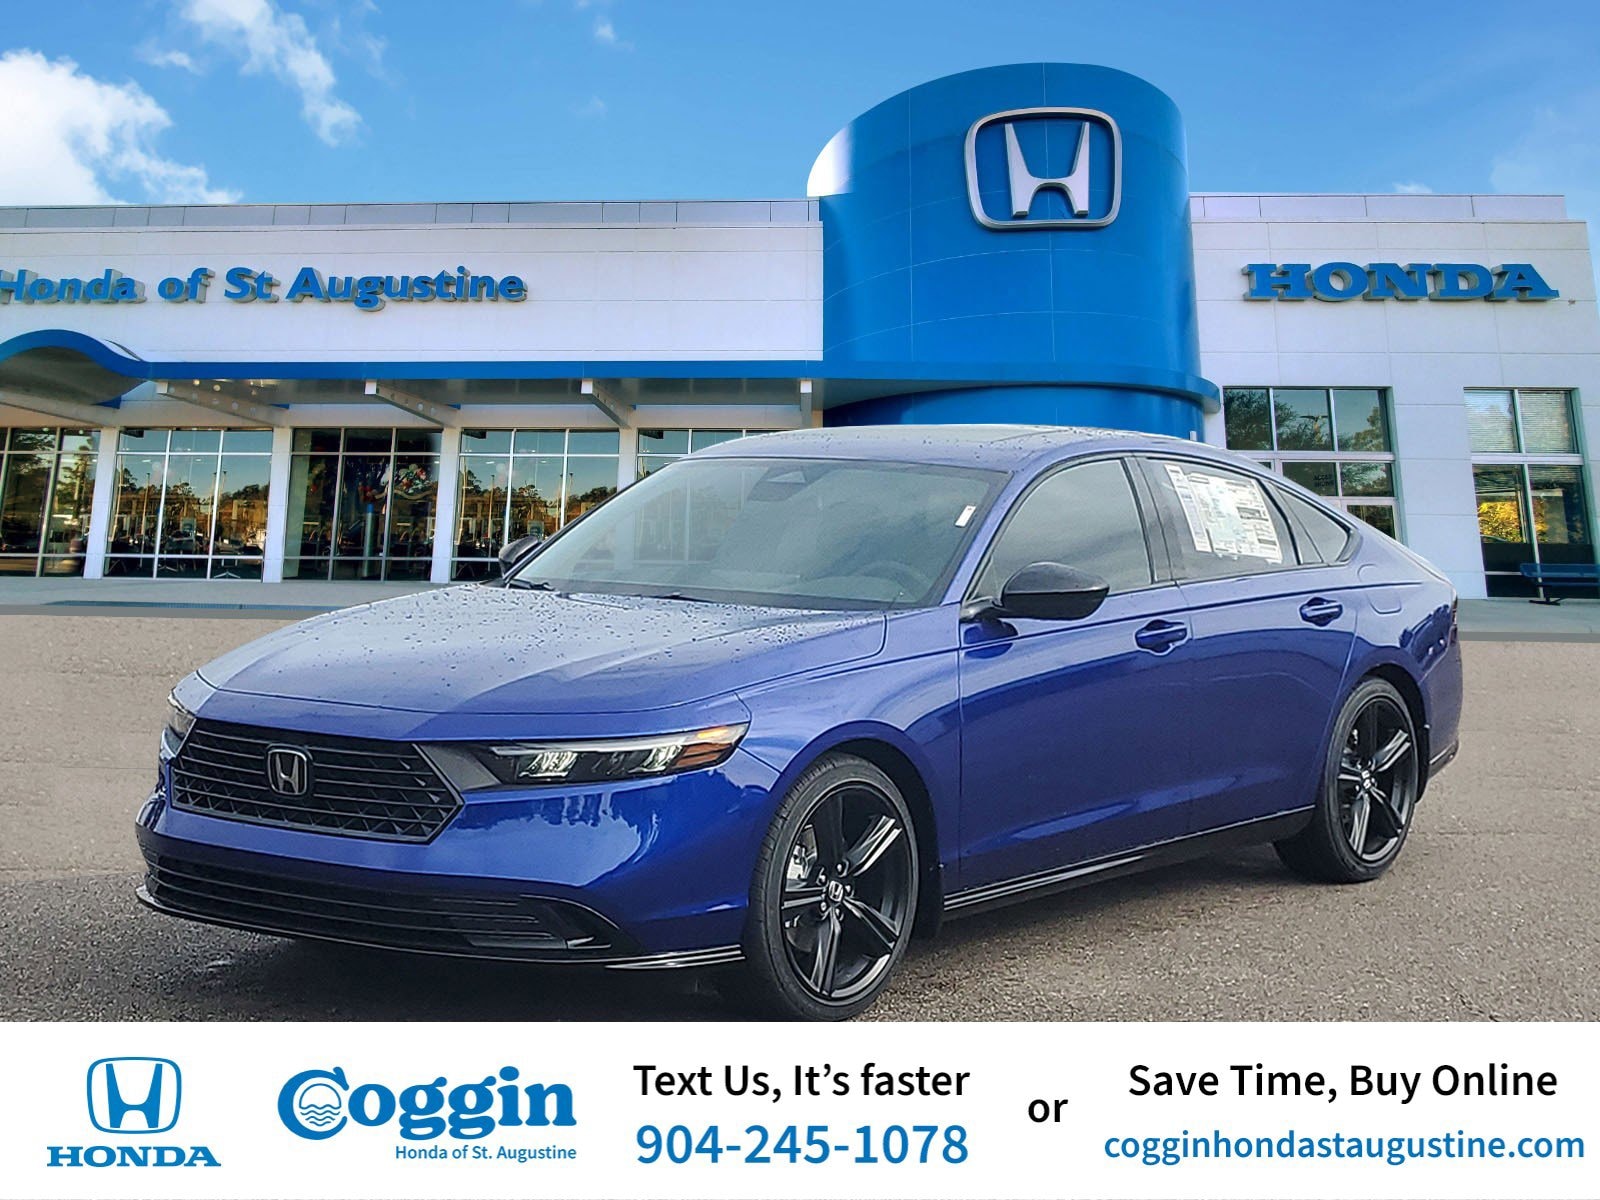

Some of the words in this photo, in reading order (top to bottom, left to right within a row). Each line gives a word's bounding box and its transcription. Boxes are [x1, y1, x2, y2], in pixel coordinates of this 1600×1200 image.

[0, 268, 143, 303] Honda
[157, 267, 213, 303] of
[223, 266, 279, 303] St
[285, 265, 527, 312] Augustine
[1242, 262, 1560, 302] HONDA
